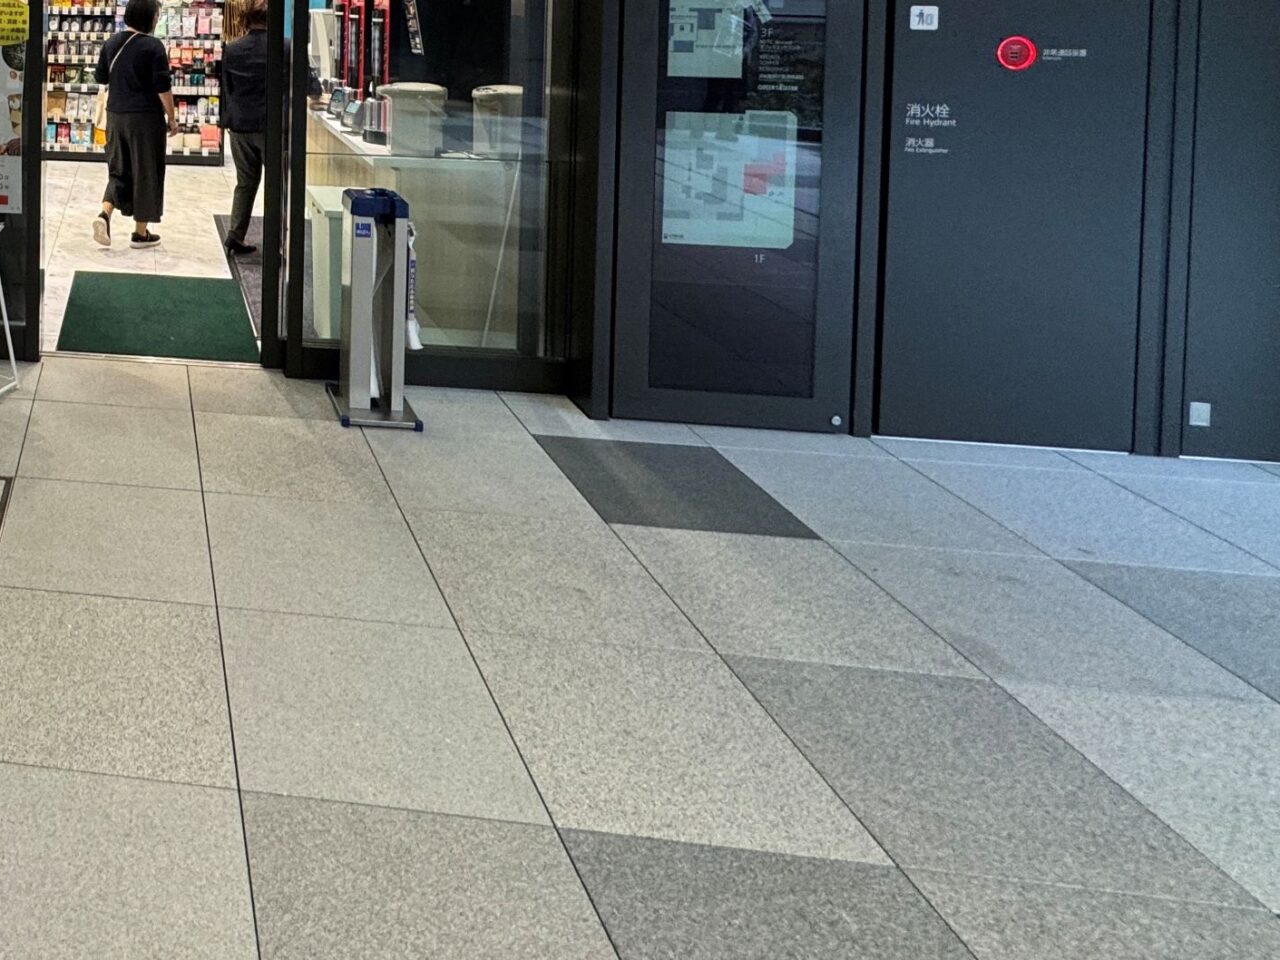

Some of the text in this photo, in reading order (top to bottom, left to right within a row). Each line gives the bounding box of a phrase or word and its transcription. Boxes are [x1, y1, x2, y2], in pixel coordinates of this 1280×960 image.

[761, 28, 773, 37] 3F
[906, 103, 950, 118] 消火栓
[905, 117, 957, 128] Fire Hydrant
[754, 254, 766, 263] 1F
